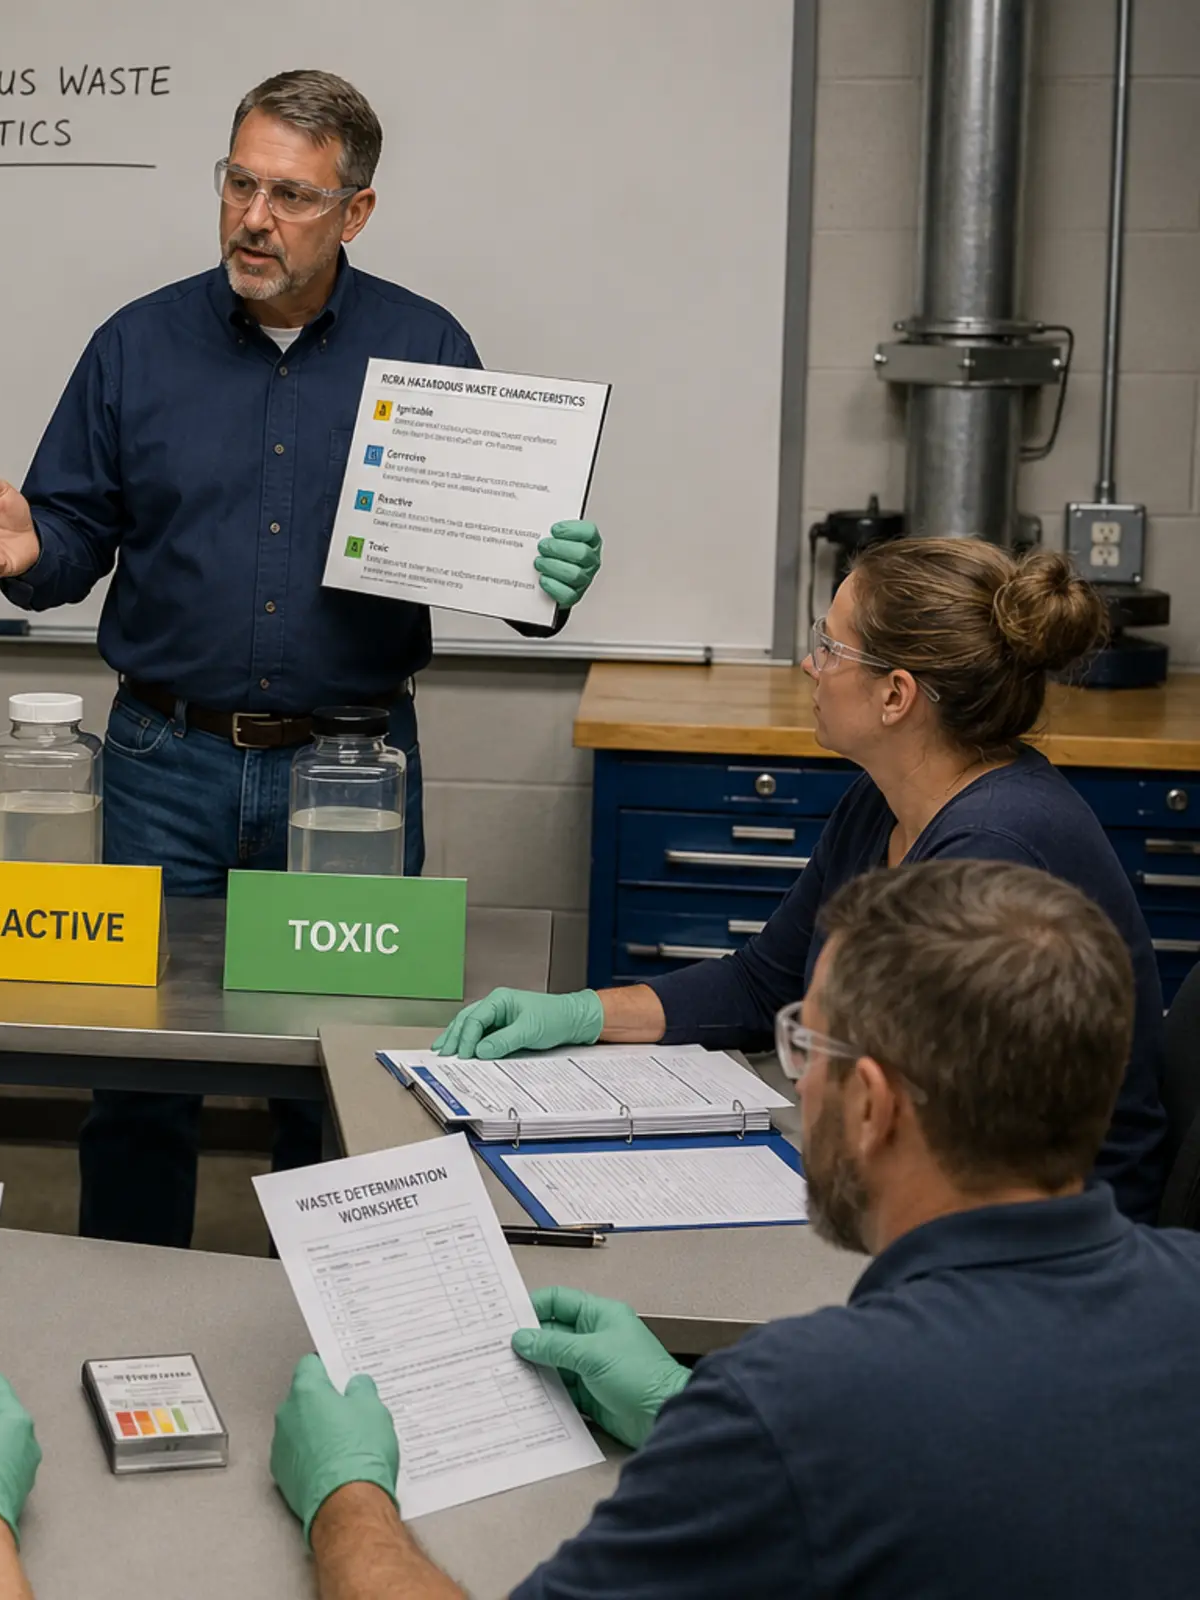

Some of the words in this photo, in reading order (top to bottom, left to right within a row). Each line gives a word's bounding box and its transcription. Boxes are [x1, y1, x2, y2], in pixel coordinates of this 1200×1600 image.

[59, 65, 172, 96] WASTE
[465, 383, 498, 396] WASTE
[499, 387, 585, 406] CHARACTERISTICS
[288, 919, 400, 955] TOXIC
[296, 1191, 343, 1212] WASTE
[344, 1166, 448, 1202] DETERMINATION
[338, 1193, 420, 1223] WORKSHEET
